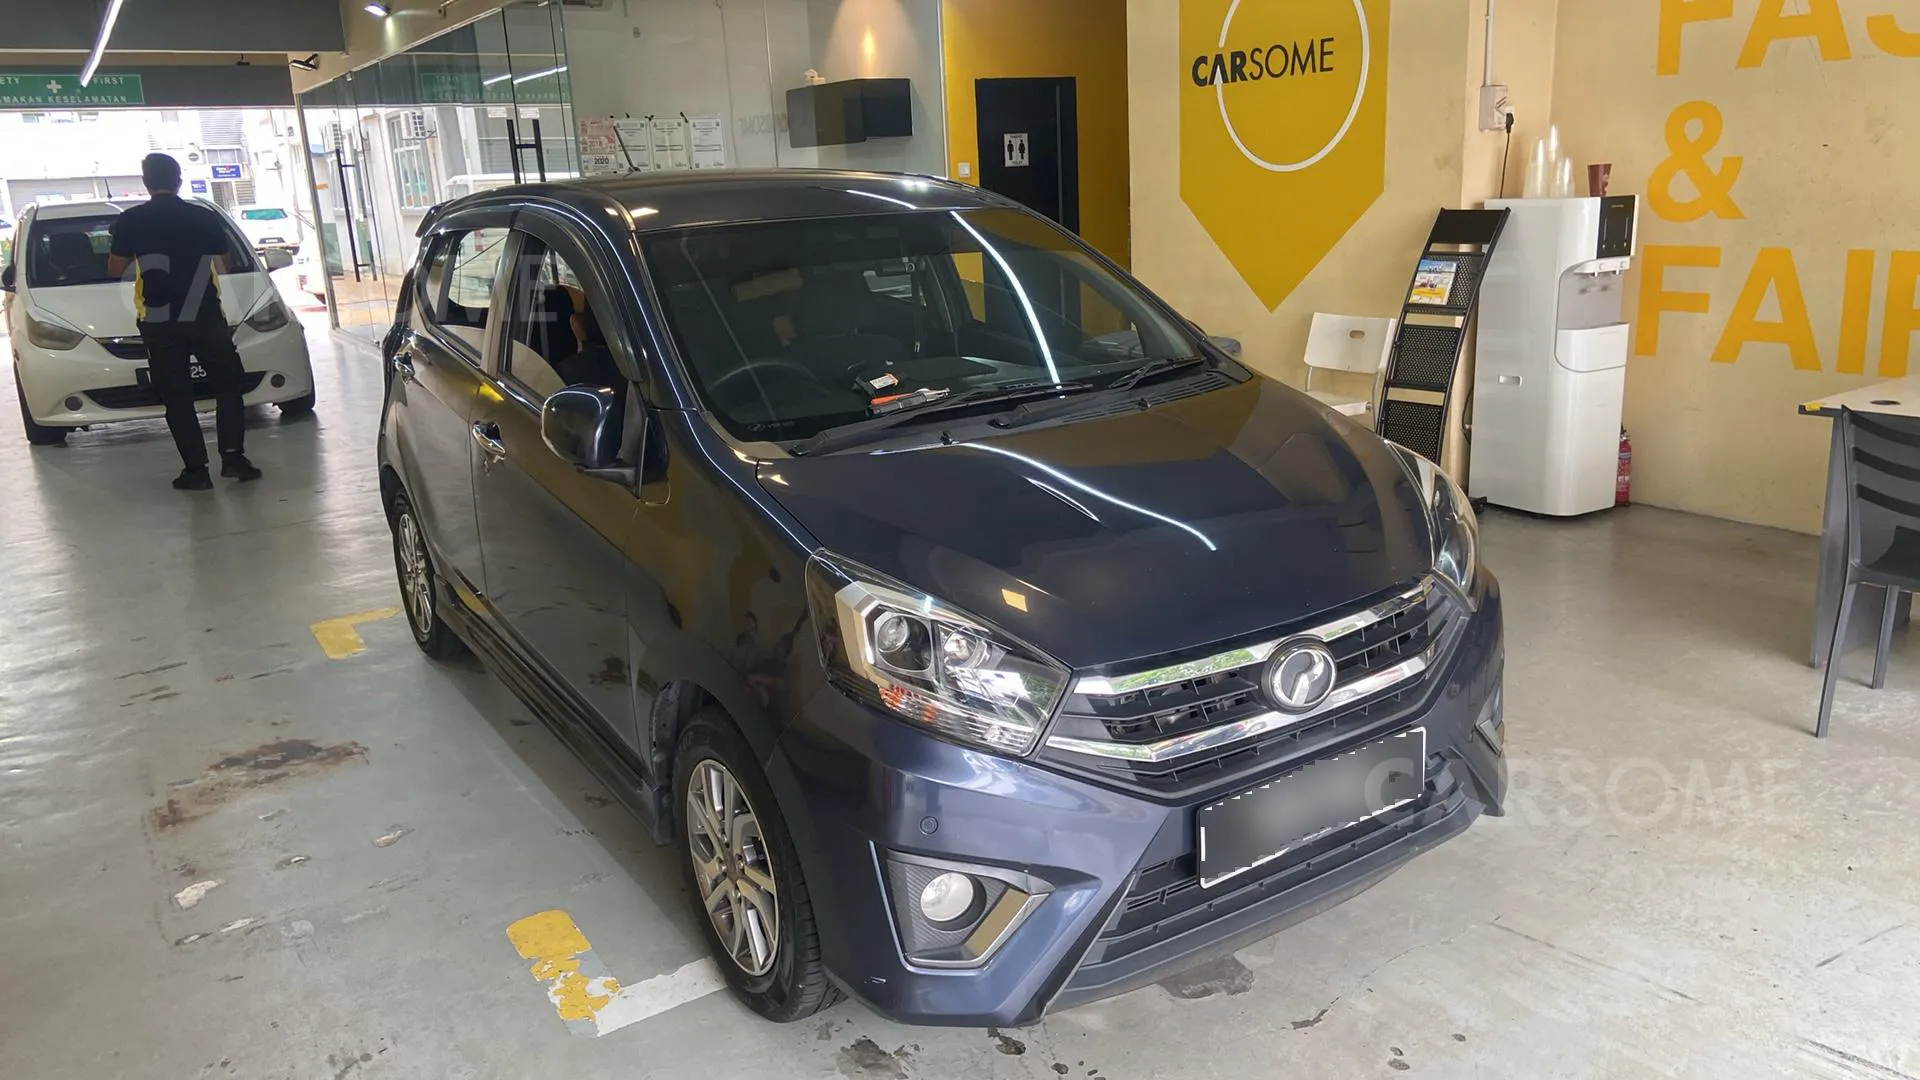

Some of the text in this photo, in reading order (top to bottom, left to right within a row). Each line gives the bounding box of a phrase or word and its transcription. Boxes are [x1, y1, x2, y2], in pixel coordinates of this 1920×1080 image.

[1192, 37, 1334, 87] CARSOME
[1656, 0, 1920, 76] FA
[0, 95, 127, 103] MAKAN KESELAMATAN
[92, 77, 124, 85] FIRST
[1647, 101, 1746, 222] &
